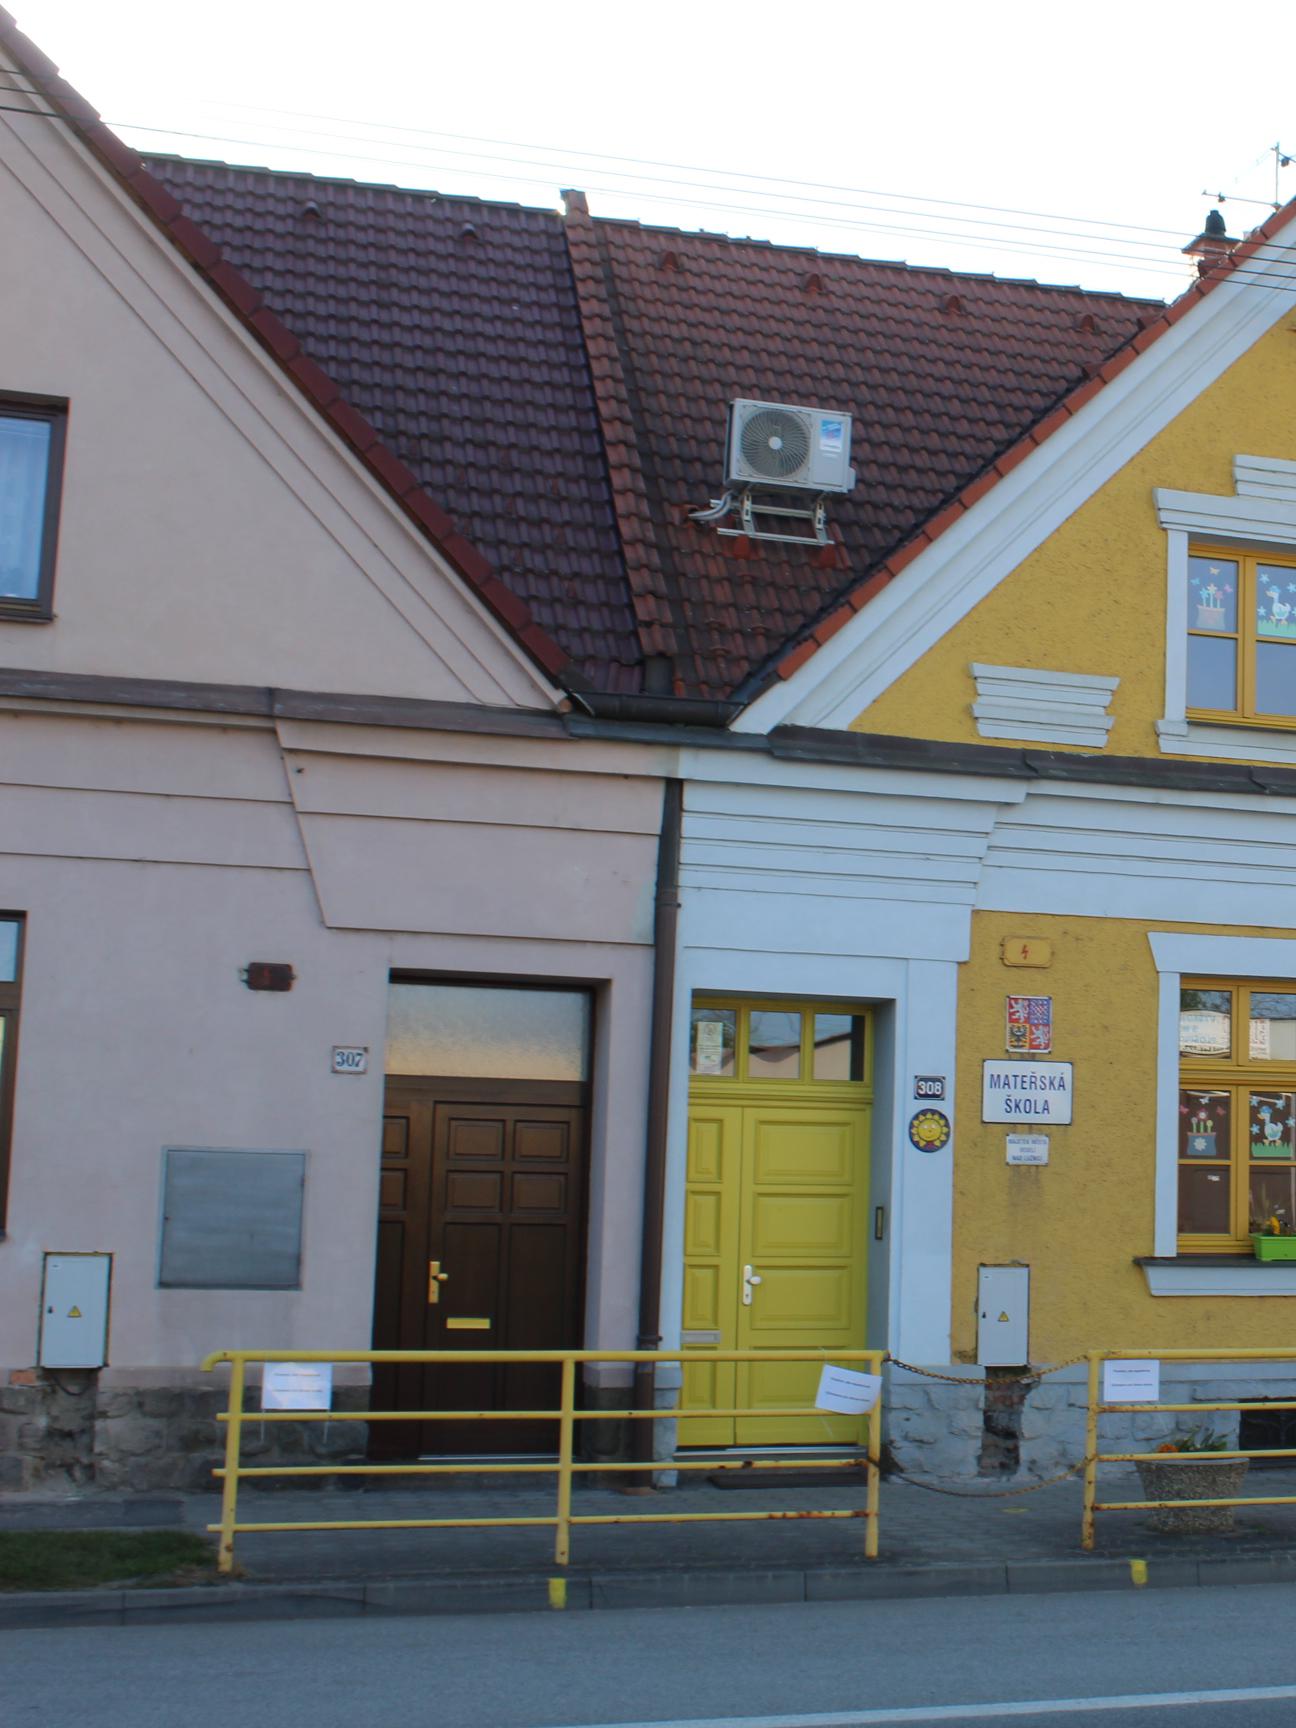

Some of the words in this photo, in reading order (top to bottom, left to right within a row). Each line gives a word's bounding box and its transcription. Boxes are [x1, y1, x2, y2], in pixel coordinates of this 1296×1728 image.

[336, 1051, 364, 1067] 307
[918, 1081, 942, 1095] 308
[989, 1072, 1066, 1091] MATEŘSKÁ
[1004, 1094, 1050, 1115] ŠKOLA
